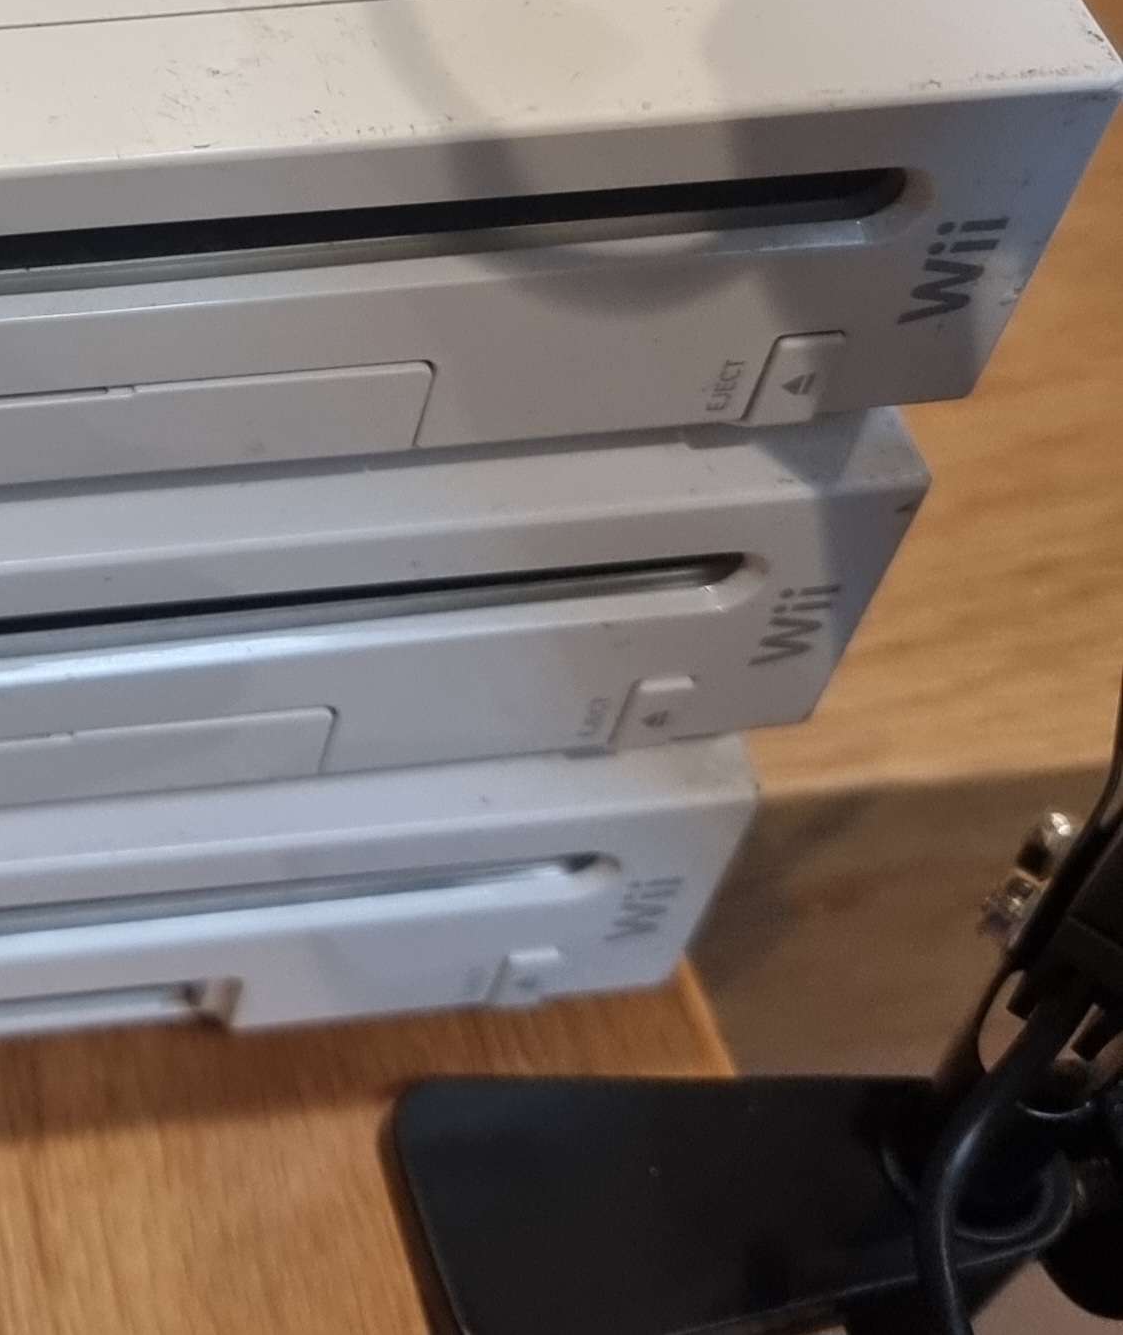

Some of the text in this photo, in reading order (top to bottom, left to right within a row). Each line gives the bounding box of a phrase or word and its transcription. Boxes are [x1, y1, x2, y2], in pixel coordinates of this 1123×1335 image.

[896, 217, 1010, 326] Wii
[704, 358, 747, 413] EJECT
[746, 583, 841, 667] Wii
[602, 875, 684, 942] Wii
